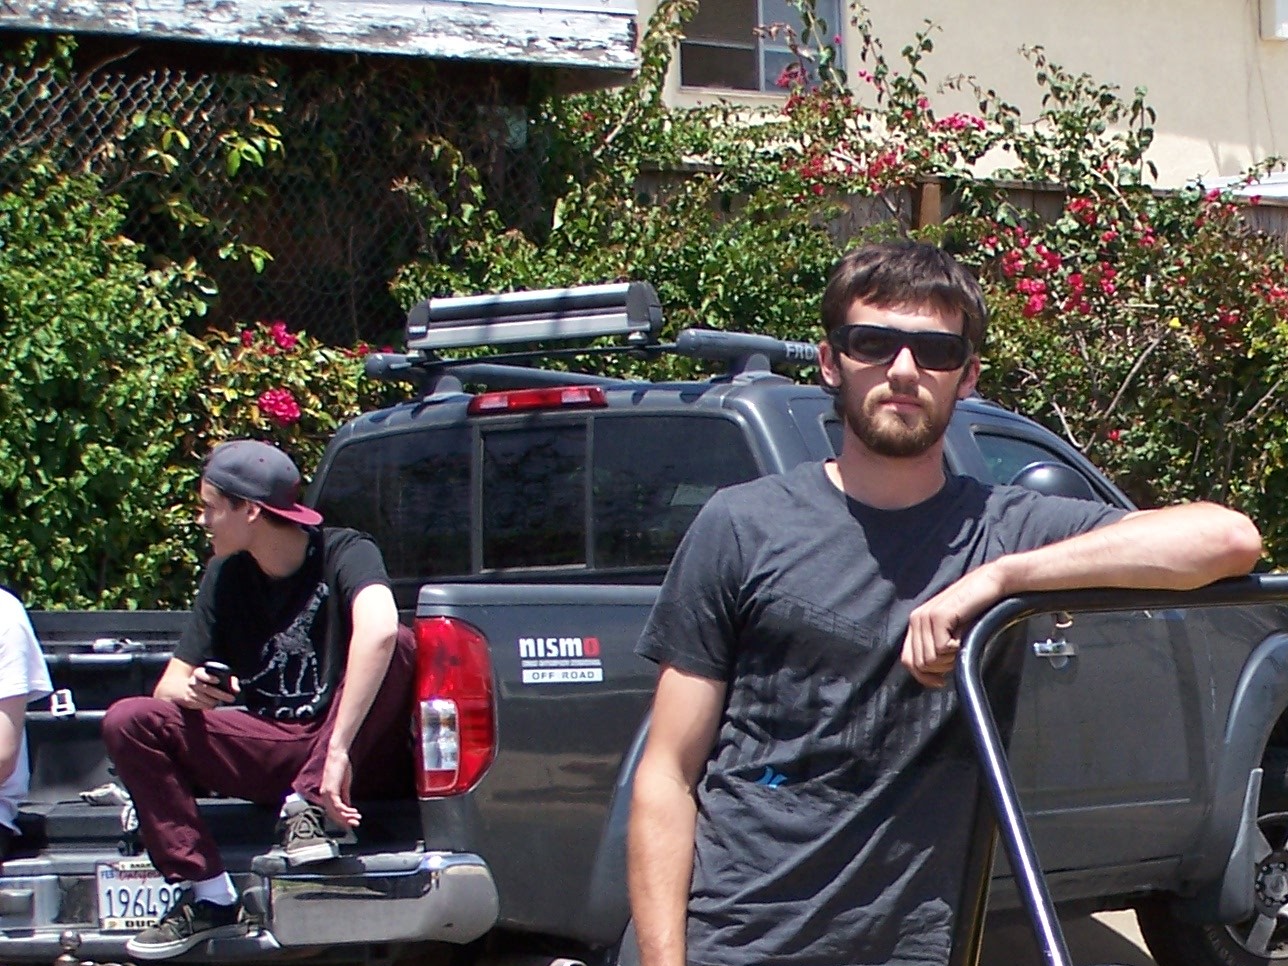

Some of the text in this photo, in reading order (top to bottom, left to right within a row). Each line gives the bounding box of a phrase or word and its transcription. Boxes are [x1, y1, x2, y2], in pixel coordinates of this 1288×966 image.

[786, 343, 818, 360] FRO
[532, 671, 595, 681] OFF ROAD
